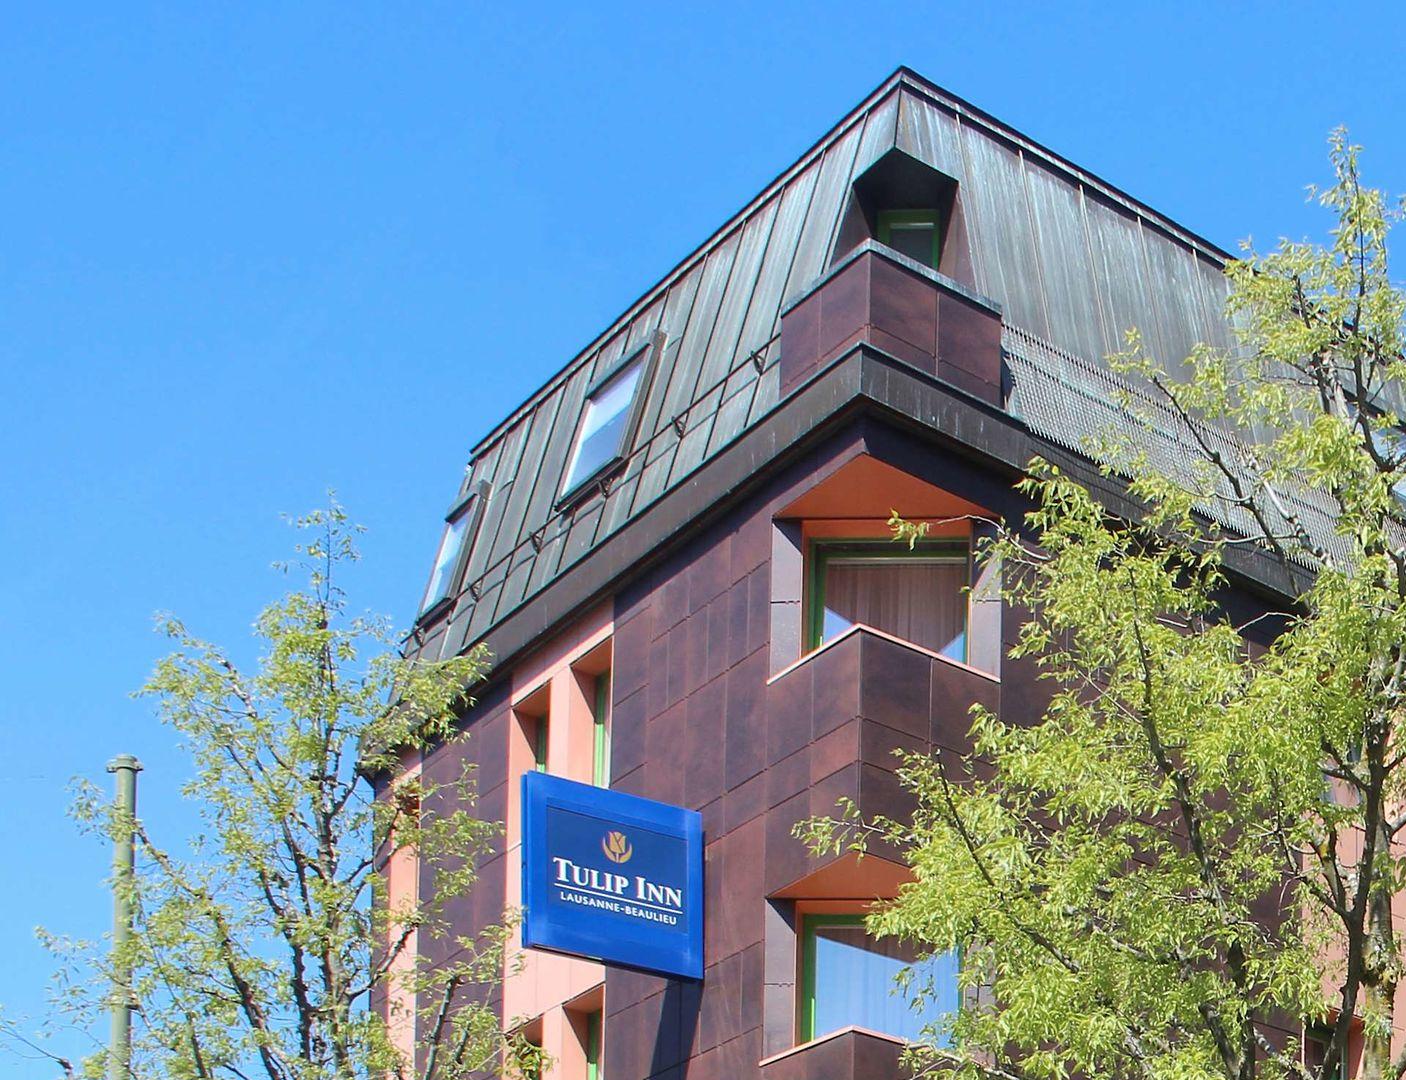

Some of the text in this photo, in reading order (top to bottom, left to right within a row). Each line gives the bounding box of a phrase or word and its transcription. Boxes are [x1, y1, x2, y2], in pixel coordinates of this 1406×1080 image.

[553, 857, 682, 908] TULIP INN
[560, 891, 677, 925] LAUSANNE-BEAULIEU
